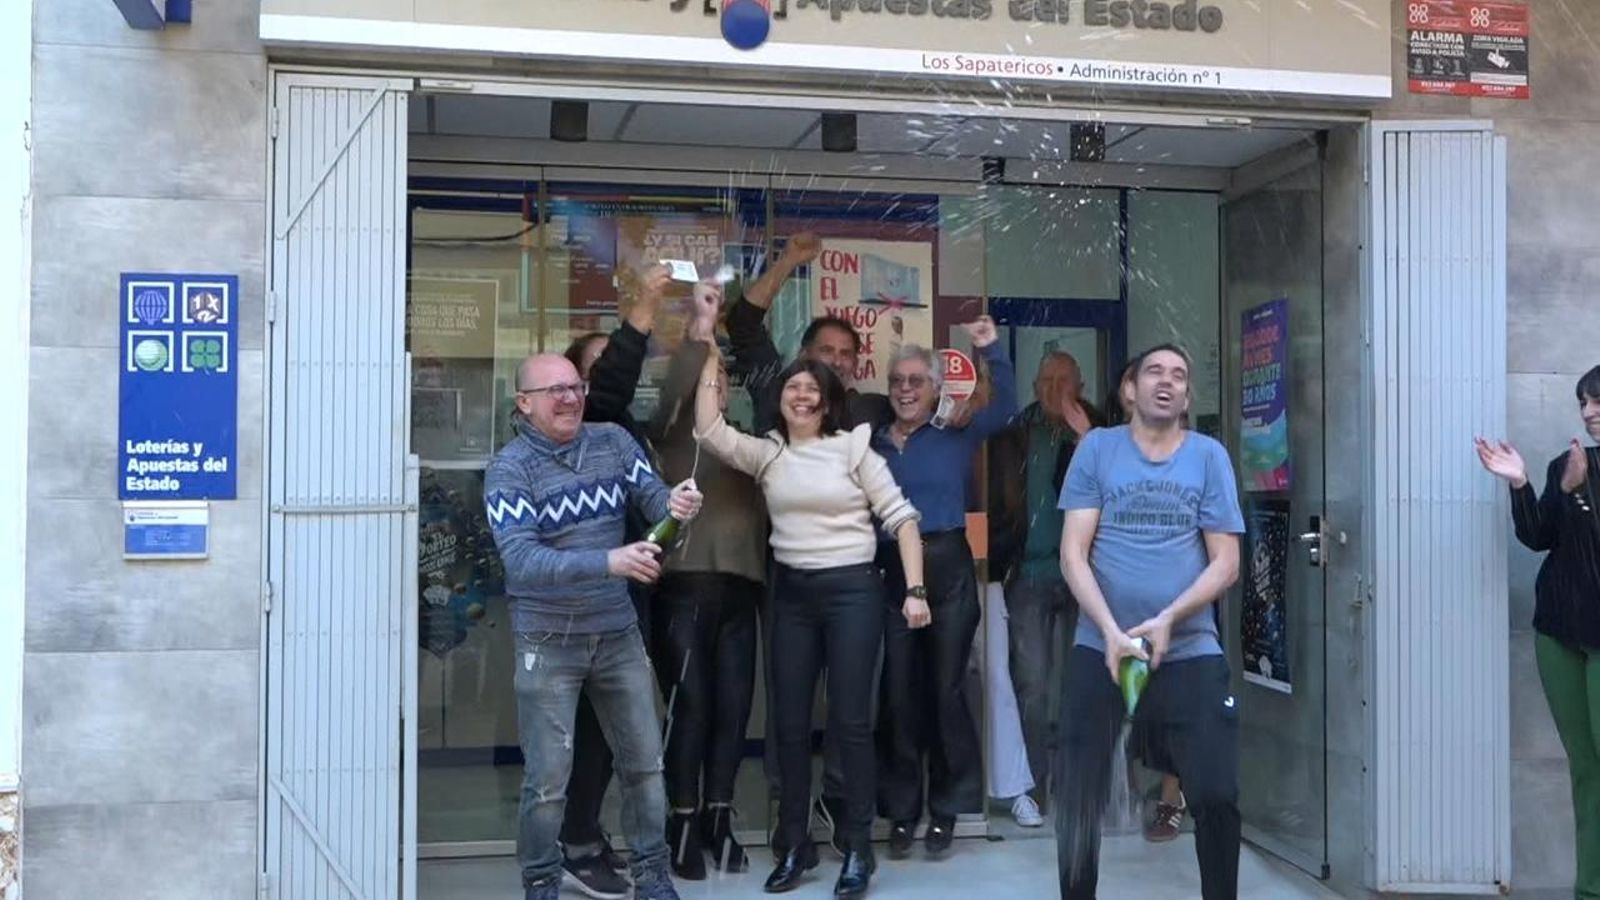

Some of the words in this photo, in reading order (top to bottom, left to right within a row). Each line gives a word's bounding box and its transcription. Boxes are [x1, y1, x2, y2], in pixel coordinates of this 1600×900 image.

[1008, 0, 1070, 25] del
[1083, 0, 1223, 33] Estado
[1410, 30, 1465, 44] ALARMA
[921, 53, 950, 70] Los
[954, 55, 1053, 75] Sapatericos
[1069, 63, 1188, 83] Administración
[1215, 72, 1222, 84] 1
[820, 250, 859, 274] CON
[820, 277, 838, 301] EL
[126, 439, 190, 454] Loterías
[193, 442, 204, 457] y
[127, 458, 199, 475] Apuestas
[203, 457, 227, 472] del
[126, 475, 180, 491] Estado
